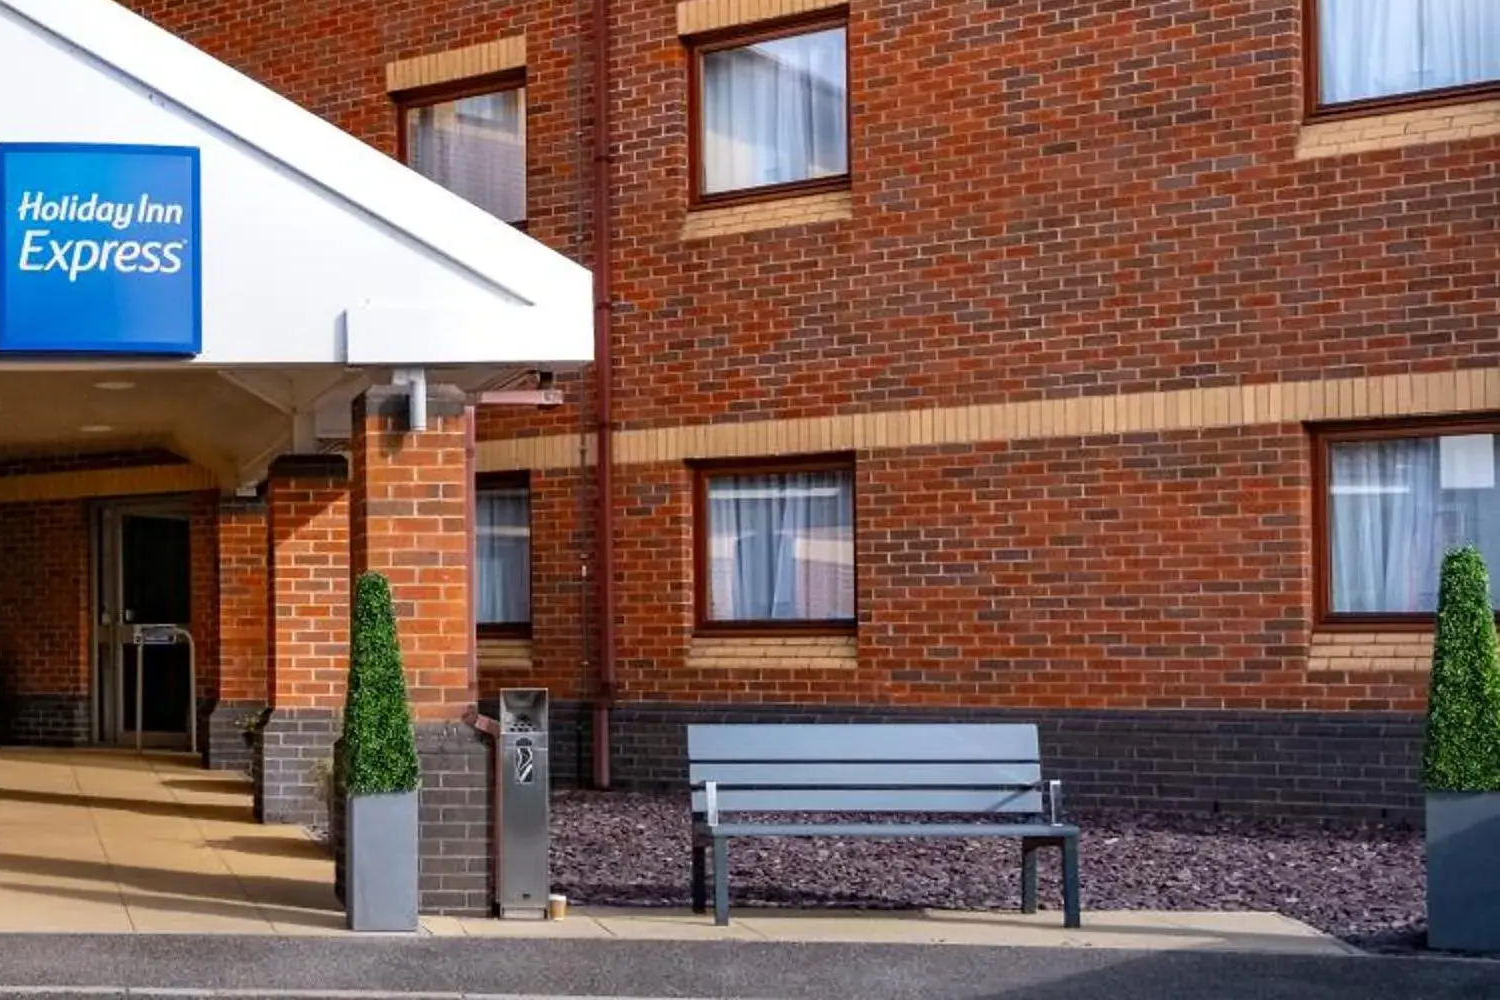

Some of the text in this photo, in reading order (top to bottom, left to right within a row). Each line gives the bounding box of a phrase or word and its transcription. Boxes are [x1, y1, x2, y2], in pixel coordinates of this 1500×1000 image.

[18, 191, 184, 229] Holiday Inn
[19, 229, 186, 282] Express
